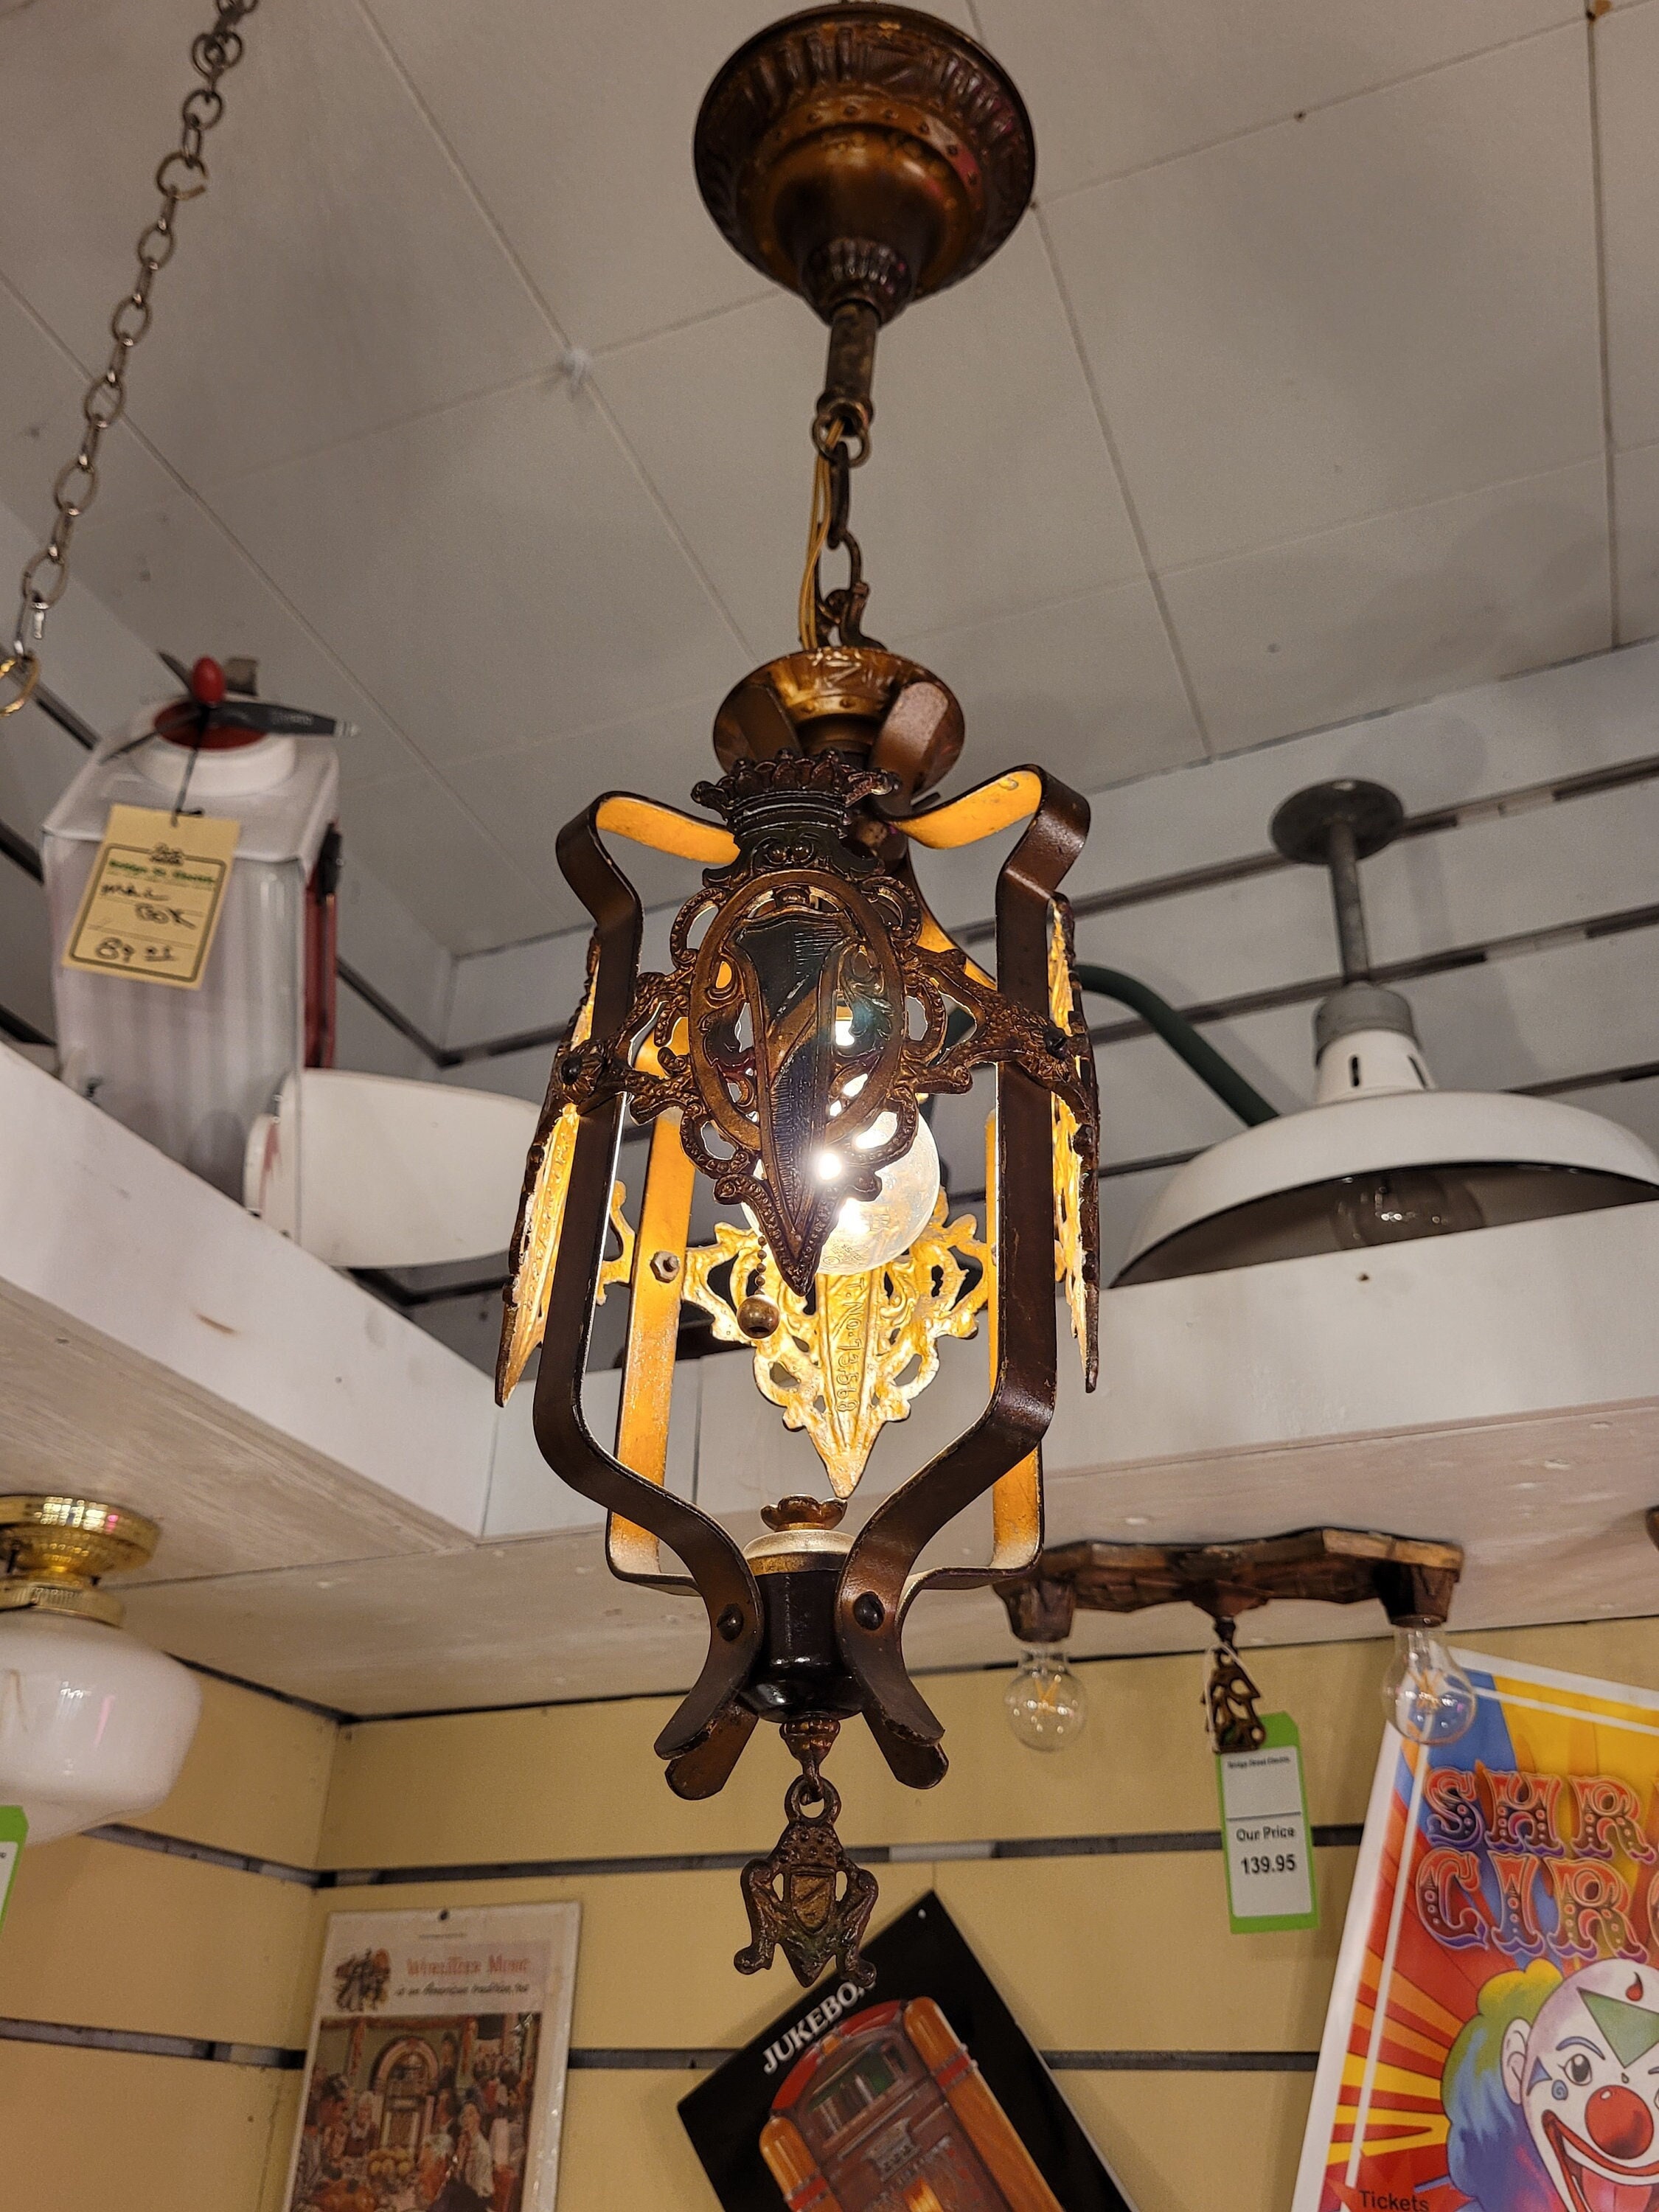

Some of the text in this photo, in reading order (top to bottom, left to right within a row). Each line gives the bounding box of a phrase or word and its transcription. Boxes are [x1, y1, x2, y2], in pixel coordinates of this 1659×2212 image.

[1236, 1825, 1295, 1842] Our Price
[1424, 1767, 1659, 1865] SHR
[1241, 1853, 1295, 1874] 139.95
[1416, 1847, 1659, 1964] CIR
[762, 1980, 877, 2076] JUKEBO
[1360, 2190, 1430, 2212] Tickets
